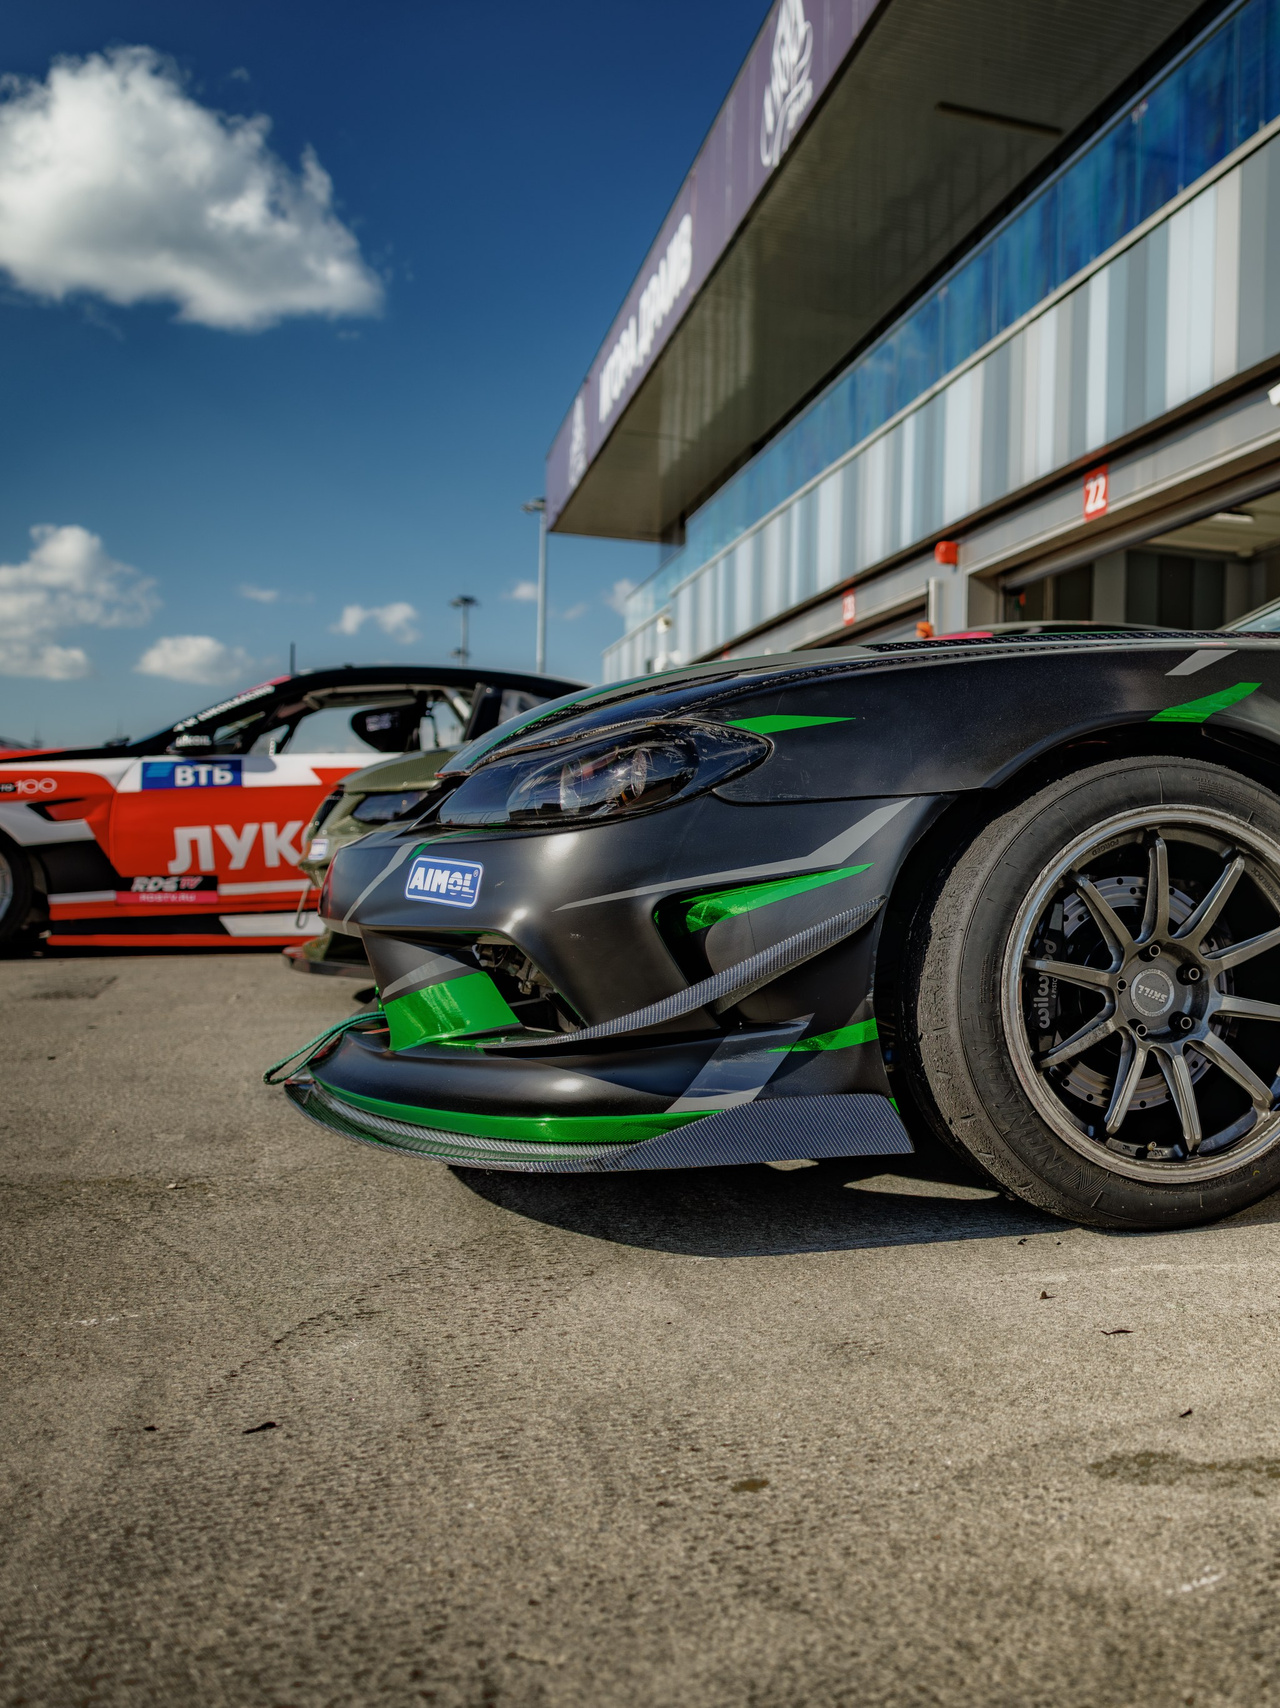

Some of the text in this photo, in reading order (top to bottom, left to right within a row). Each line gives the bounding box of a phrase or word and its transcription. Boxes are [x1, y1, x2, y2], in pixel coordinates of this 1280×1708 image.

[1085, 474, 1107, 513] 22
[174, 764, 234, 787] ВТБ
[168, 820, 308, 874] ЛУК
[1033, 939, 1057, 1029] wilwod
